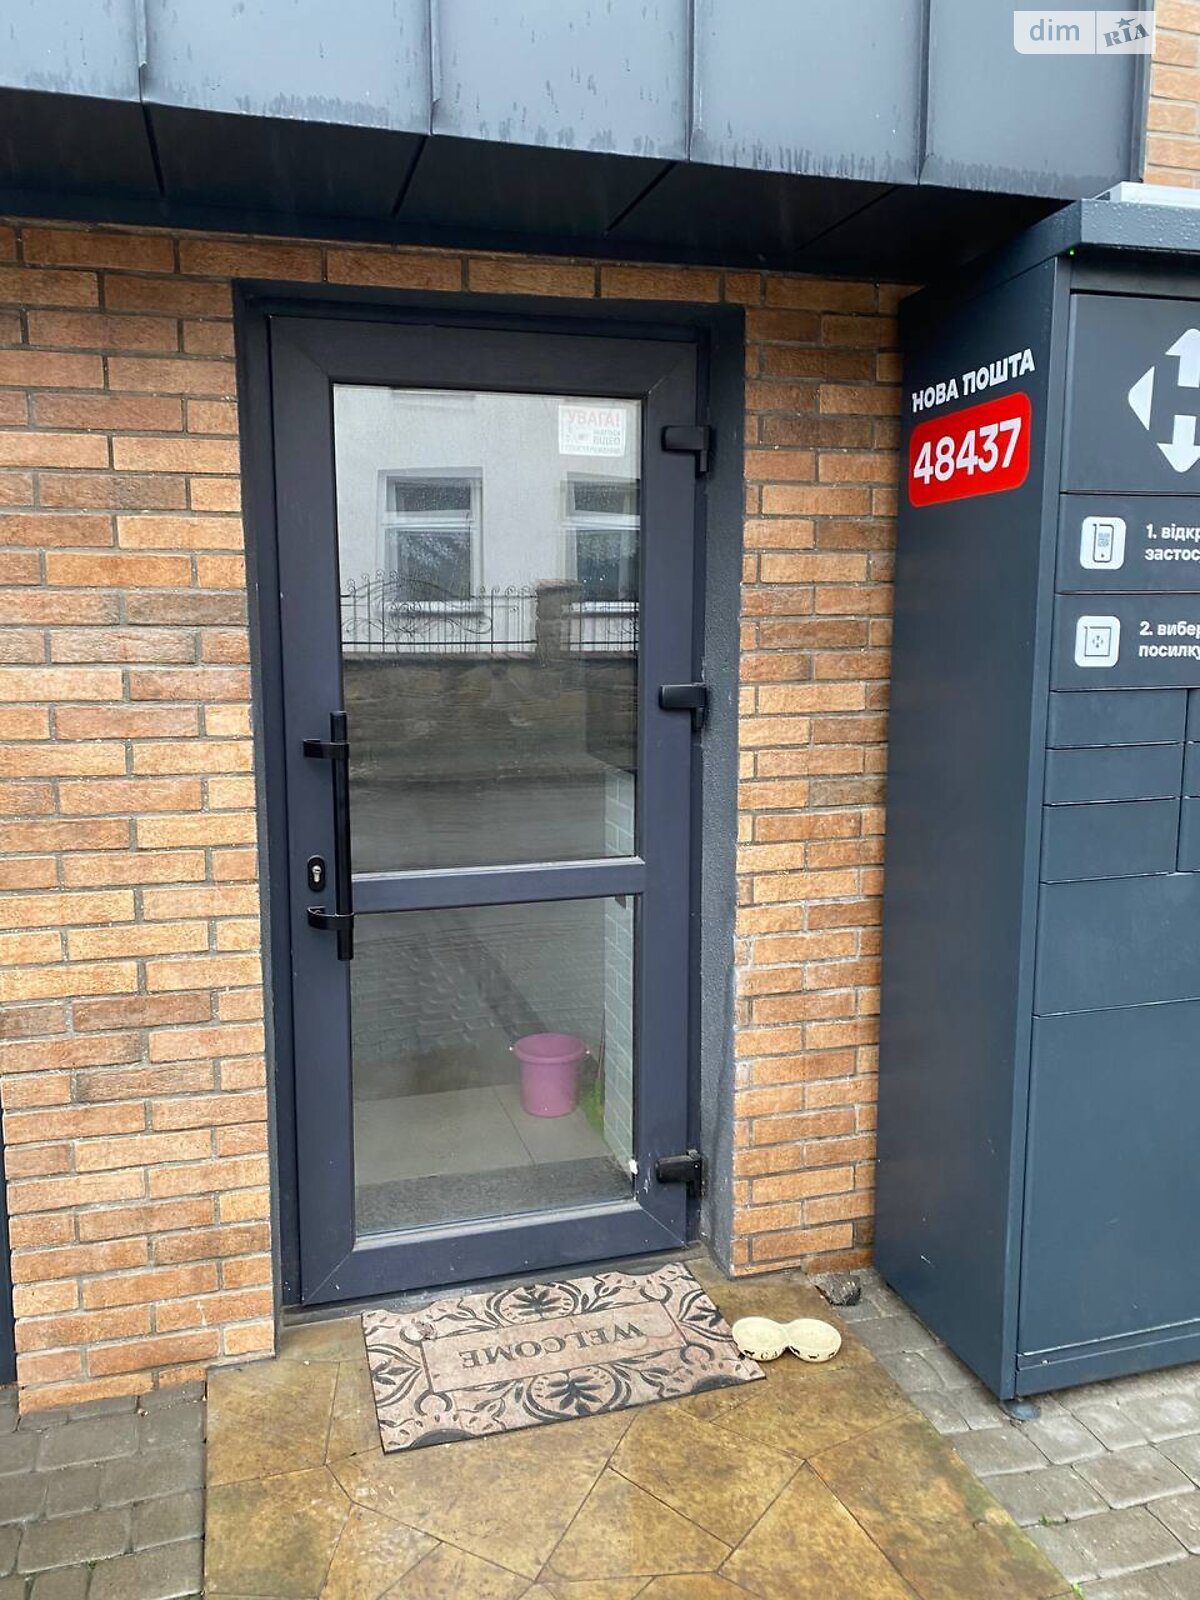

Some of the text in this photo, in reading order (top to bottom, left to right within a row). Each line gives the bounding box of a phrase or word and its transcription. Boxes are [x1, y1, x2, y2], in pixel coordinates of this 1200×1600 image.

[912, 348, 1035, 413] НОВА ПОШТА
[568, 409, 620, 427] УВАГА!
[913, 417, 1022, 485] 48437
[1145, 523, 1200, 543] 1. відкр
[1139, 620, 1153, 636] 2.
[459, 1322, 645, 1369] WELCOME
